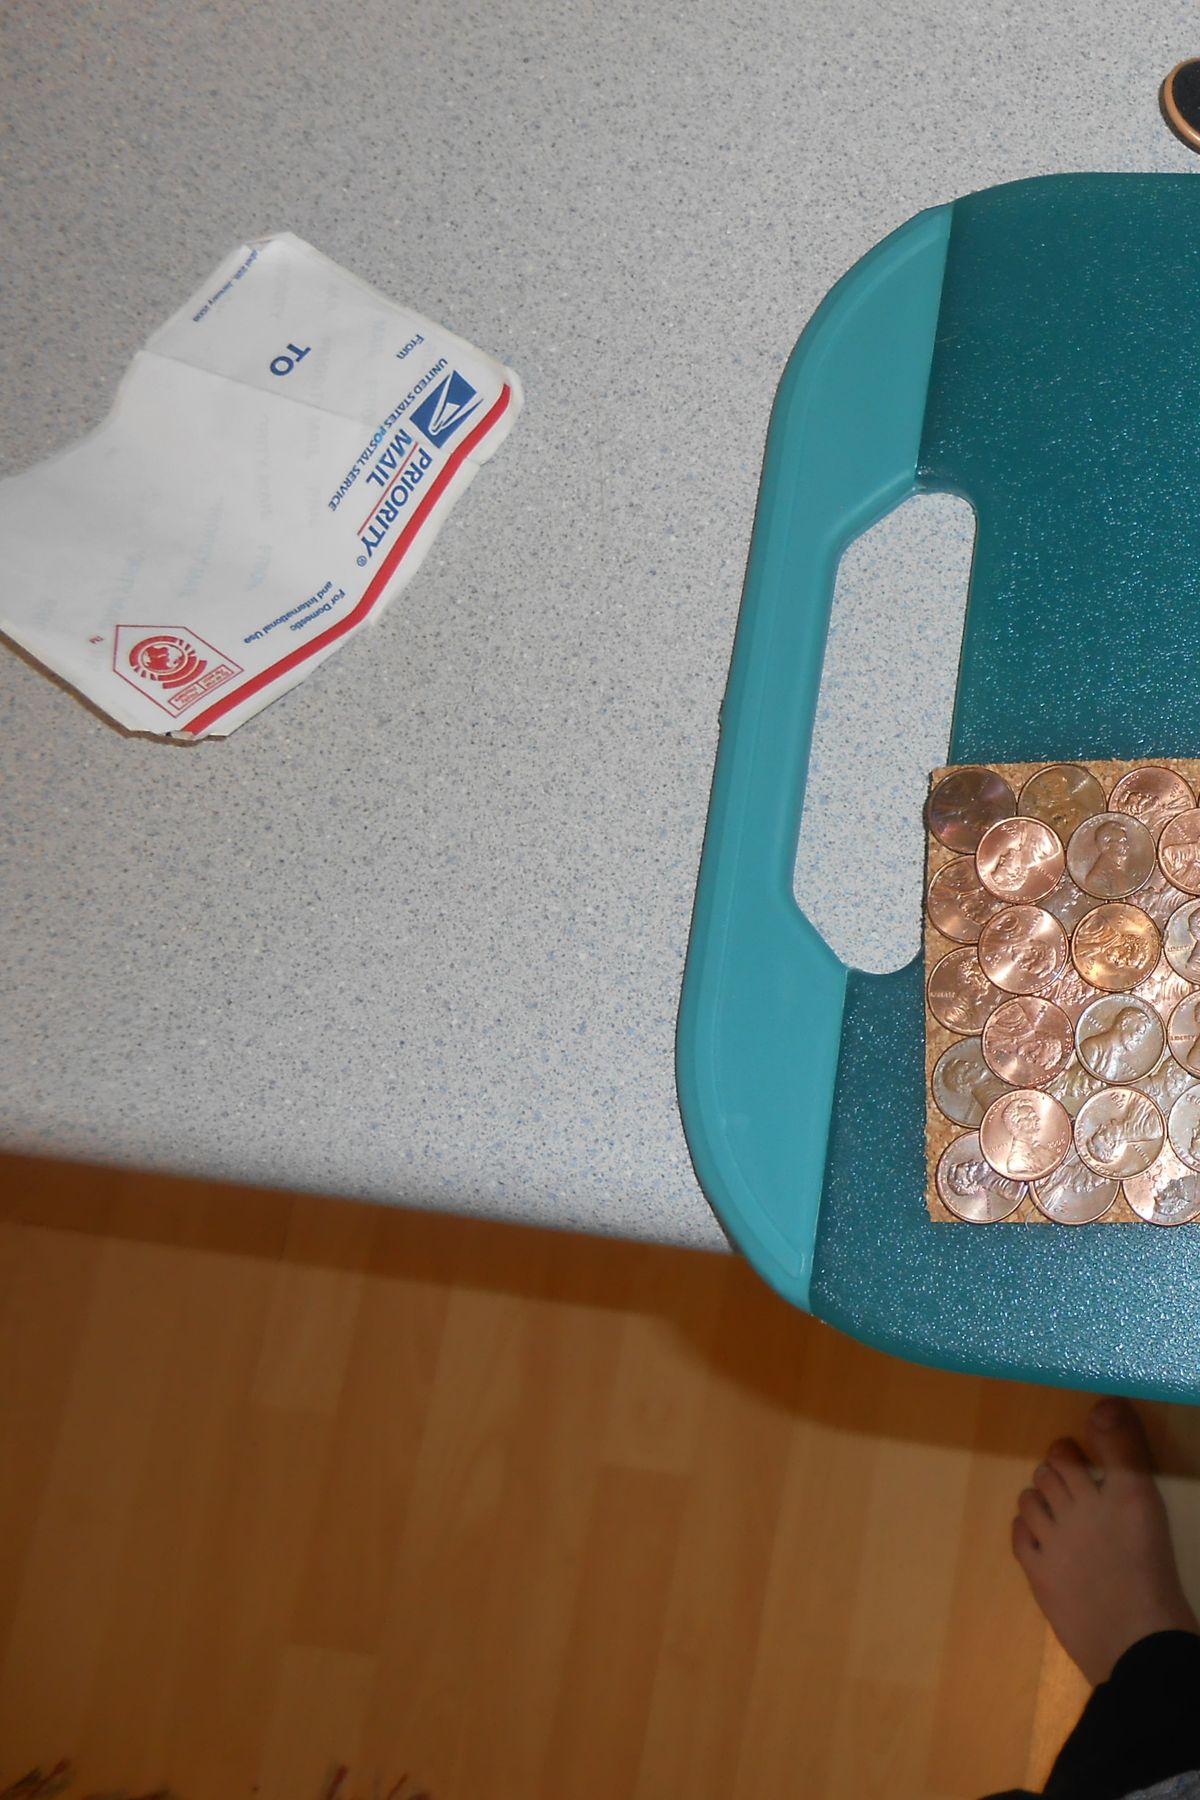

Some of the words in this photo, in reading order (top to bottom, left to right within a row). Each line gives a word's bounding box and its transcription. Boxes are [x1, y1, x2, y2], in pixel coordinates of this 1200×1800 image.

[269, 343, 312, 377] TO
[395, 333, 425, 360] From
[413, 357, 449, 395] UNITED
[383, 391, 416, 429] STATES
[355, 425, 387, 467] POSTAL
[365, 428, 414, 488] MAIL
[328, 464, 361, 512] SERVICE
[316, 580, 333, 600] and
[331, 588, 346, 606] For
[262, 596, 319, 634] International
[289, 602, 333, 632] Domestic
[243, 630, 264, 644] Use
